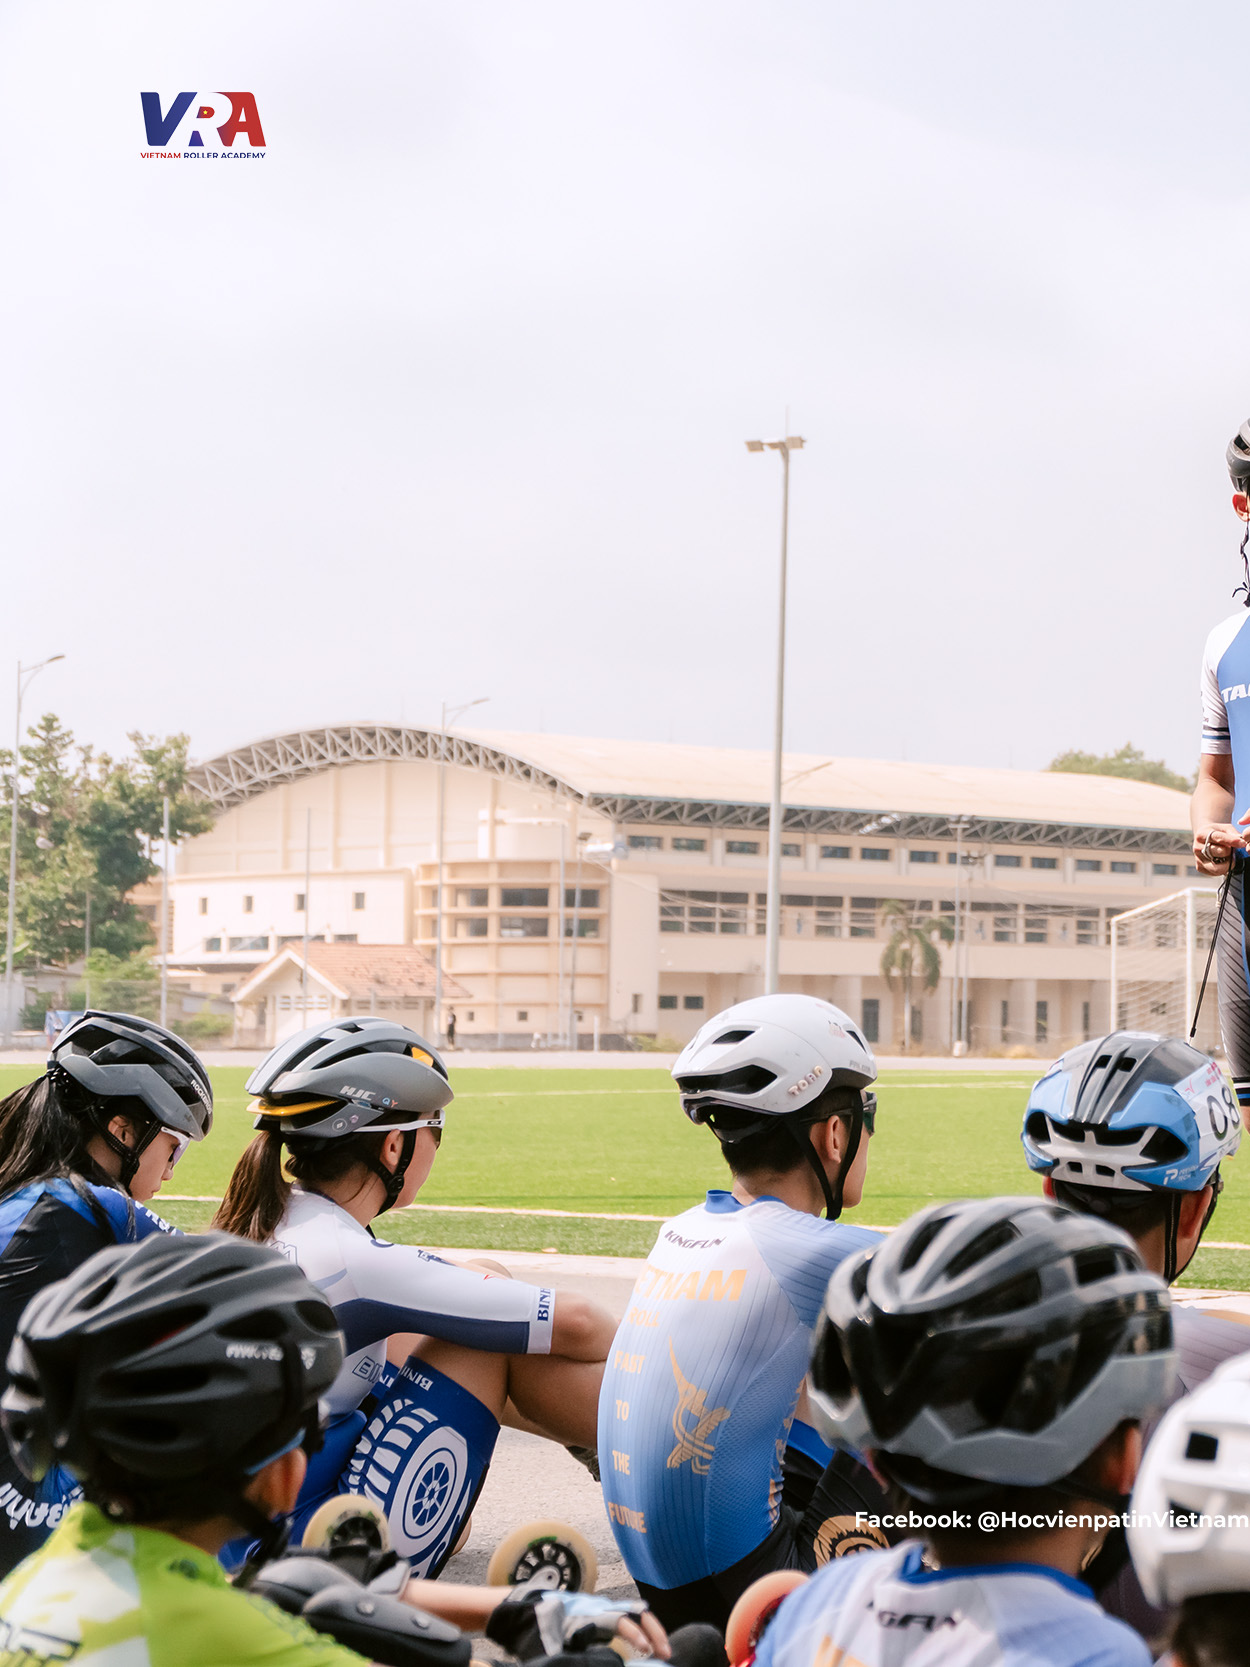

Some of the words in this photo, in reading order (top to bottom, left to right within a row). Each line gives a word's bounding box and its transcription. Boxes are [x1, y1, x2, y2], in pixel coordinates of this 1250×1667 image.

[340, 1085, 376, 1101] HJC
[664, 1230, 727, 1249] KINGFUN
[627, 1306, 660, 1327] ROLL
[614, 1351, 646, 1374] FAST
[616, 1400, 629, 1421] TO
[612, 1450, 630, 1475] THE
[607, 1501, 647, 1534] FUTURE
